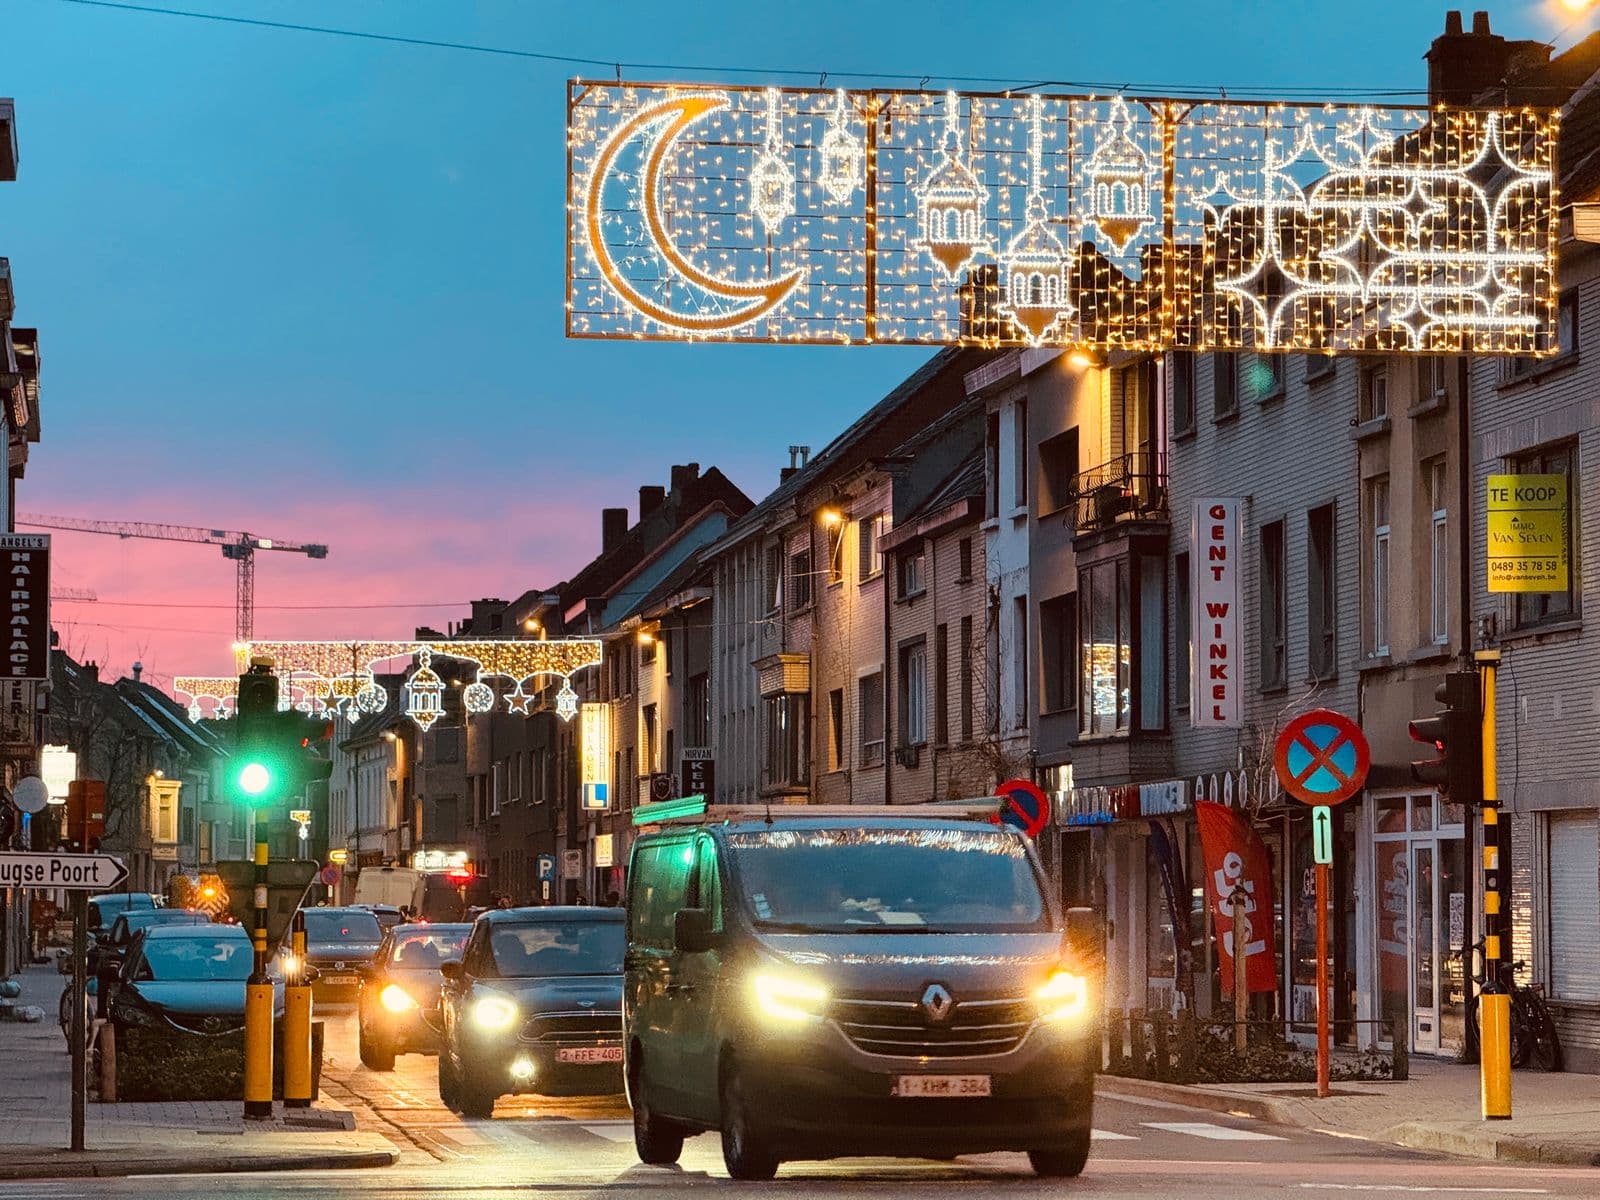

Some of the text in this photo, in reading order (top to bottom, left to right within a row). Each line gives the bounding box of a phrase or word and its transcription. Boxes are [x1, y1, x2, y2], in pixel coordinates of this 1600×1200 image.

[1490, 487, 1557, 502] TE KOOP
[0, 538, 43, 548] ANGEL'S
[1491, 561, 1557, 571] 0489 35 78 58
[1206, 505, 1229, 720] GENT WINKEL
[691, 762, 705, 795] KEU
[50, 860, 99, 882] Poort
